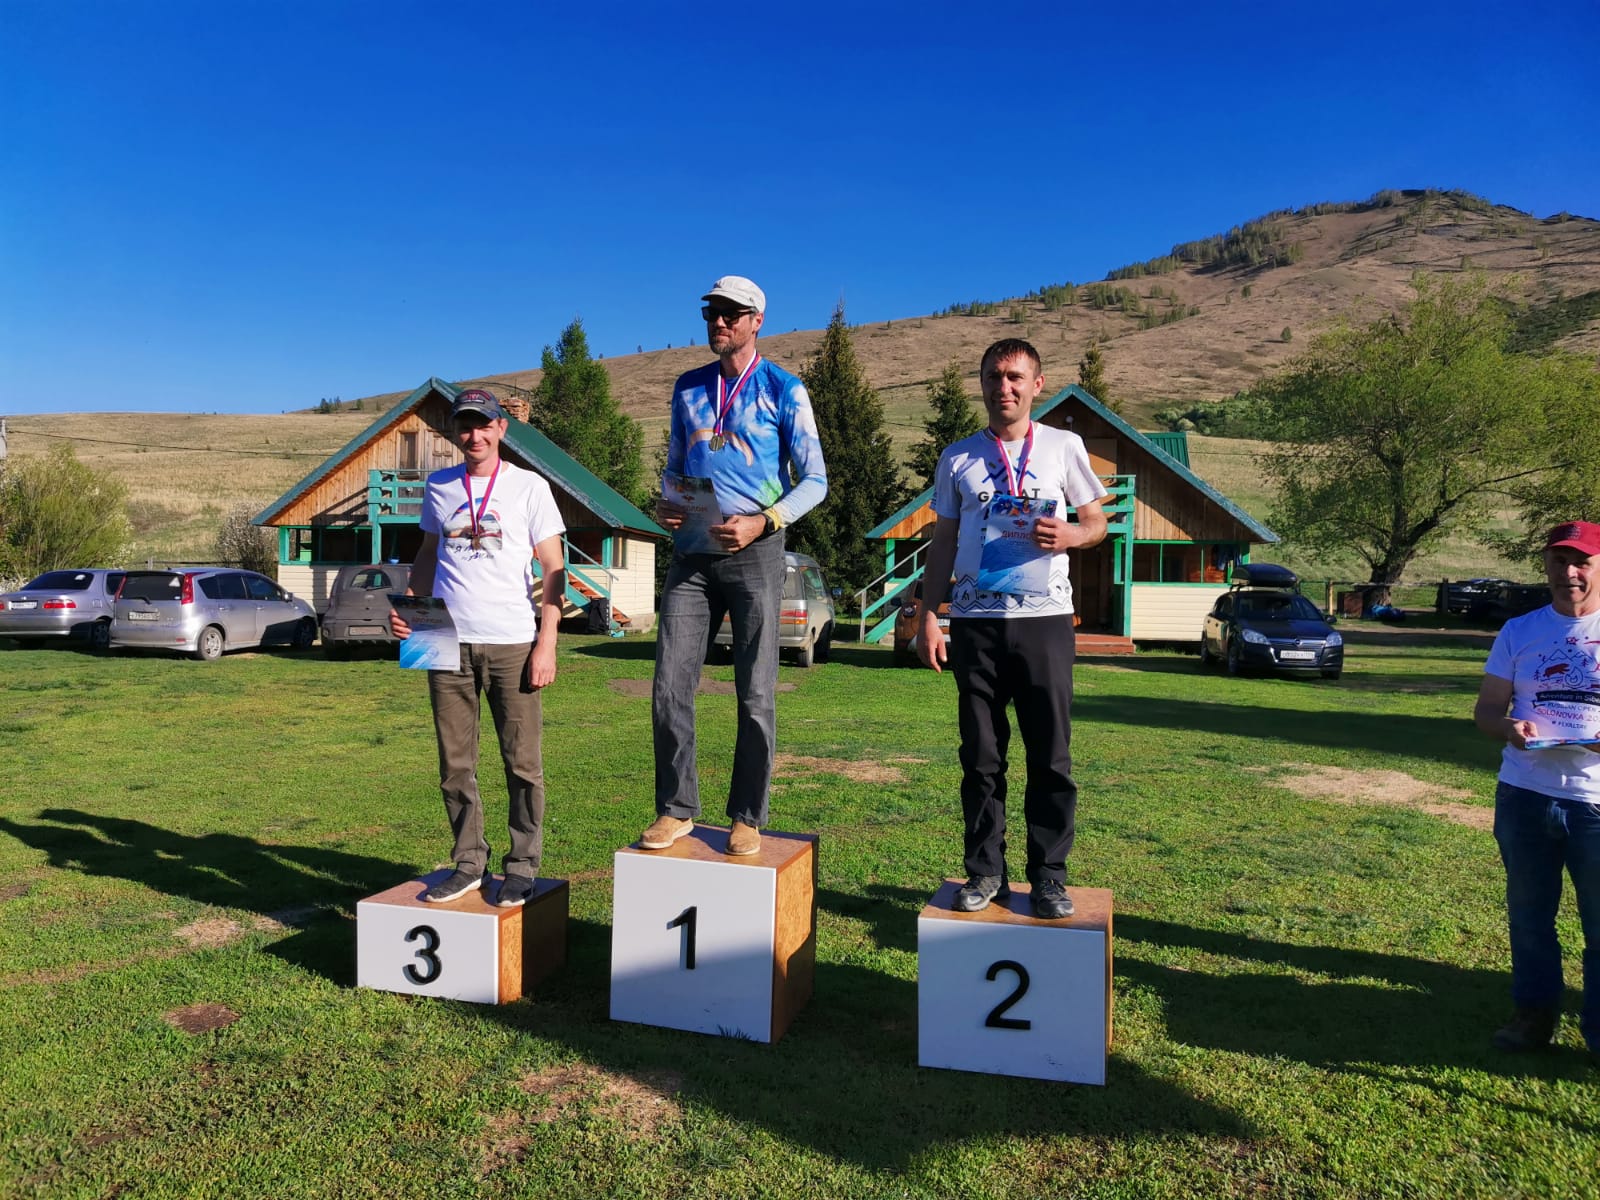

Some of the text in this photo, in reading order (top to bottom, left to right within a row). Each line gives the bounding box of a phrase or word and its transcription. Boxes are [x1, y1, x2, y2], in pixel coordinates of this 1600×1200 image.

[978, 488, 1041, 503] GAT
[1001, 529, 1032, 540] ДИПЛО
[1536, 707, 1584, 721] SOLONOVKA
[402, 925, 442, 985] 3
[667, 906, 697, 970] 1
[985, 959, 1031, 1030] 2
